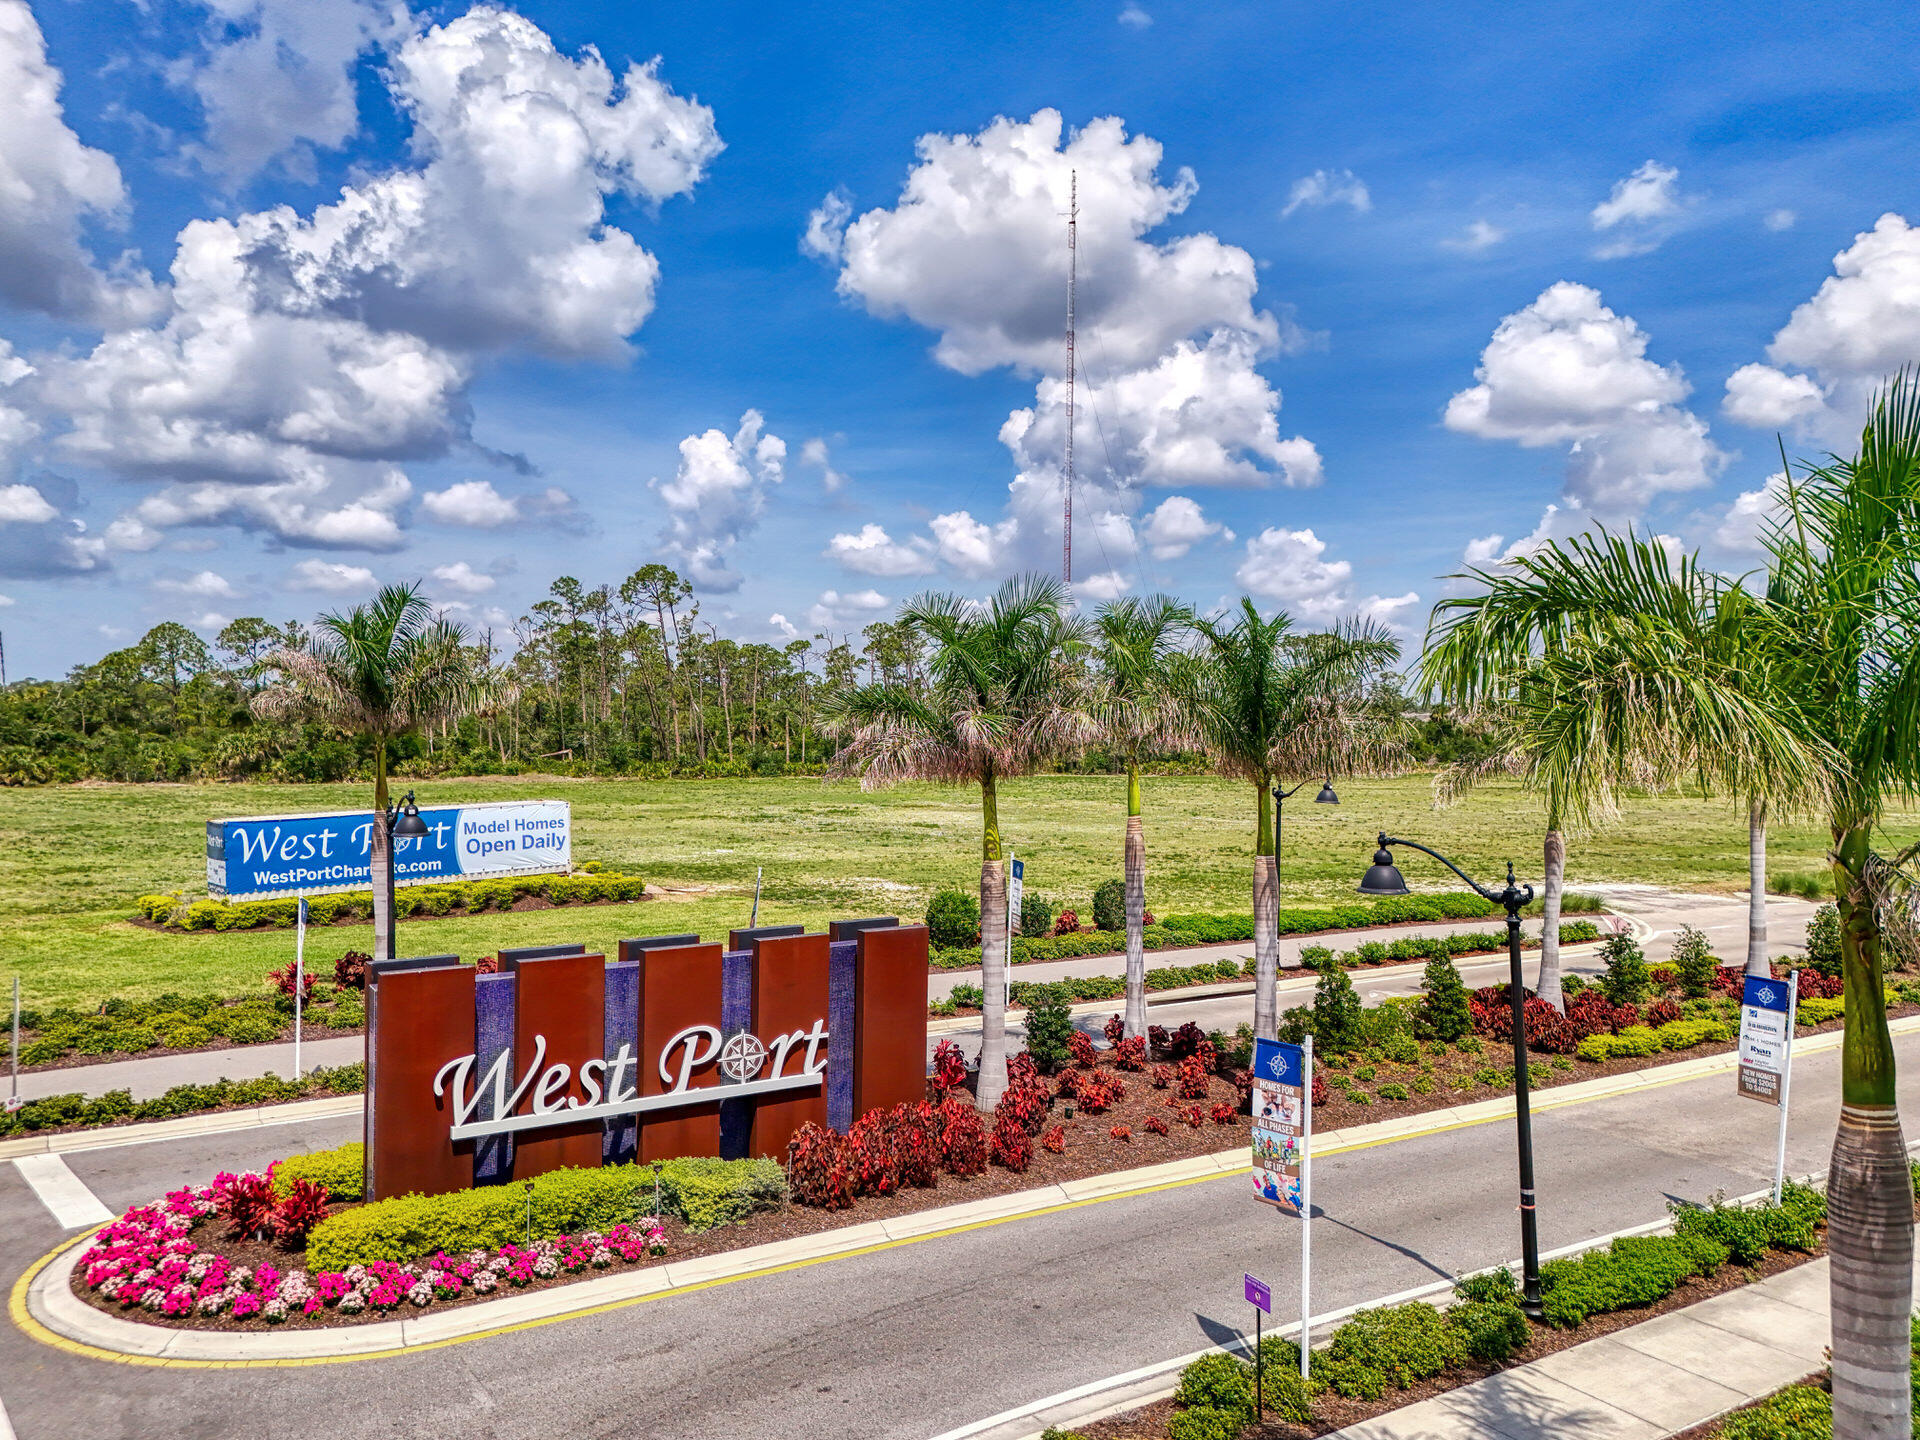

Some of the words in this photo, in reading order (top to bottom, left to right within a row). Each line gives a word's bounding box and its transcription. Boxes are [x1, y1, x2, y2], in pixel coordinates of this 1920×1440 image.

[464, 820, 510, 835] Model
[515, 819, 565, 831] Homes
[232, 826, 339, 864] West
[466, 838, 515, 856] Open
[522, 832, 566, 850] Daily
[253, 860, 442, 885] WestPortCharte.com
[1750, 1045, 1772, 1055] Ryan
[433, 1034, 638, 1127] West
[659, 1019, 830, 1096] Port
[1741, 1075, 1757, 1084] FROM
[1742, 1068, 1755, 1077] NEW
[1755, 1070, 1776, 1082] HOMES
[1259, 1080, 1281, 1093] HOMES
[1282, 1084, 1295, 1096] FOR
[1745, 1082, 1753, 1090] TO
[1257, 1118, 1269, 1130] ALL
[1269, 1121, 1294, 1135] PHASES
[1264, 1160, 1272, 1170] OF
[1272, 1162, 1286, 1174] LIFE
